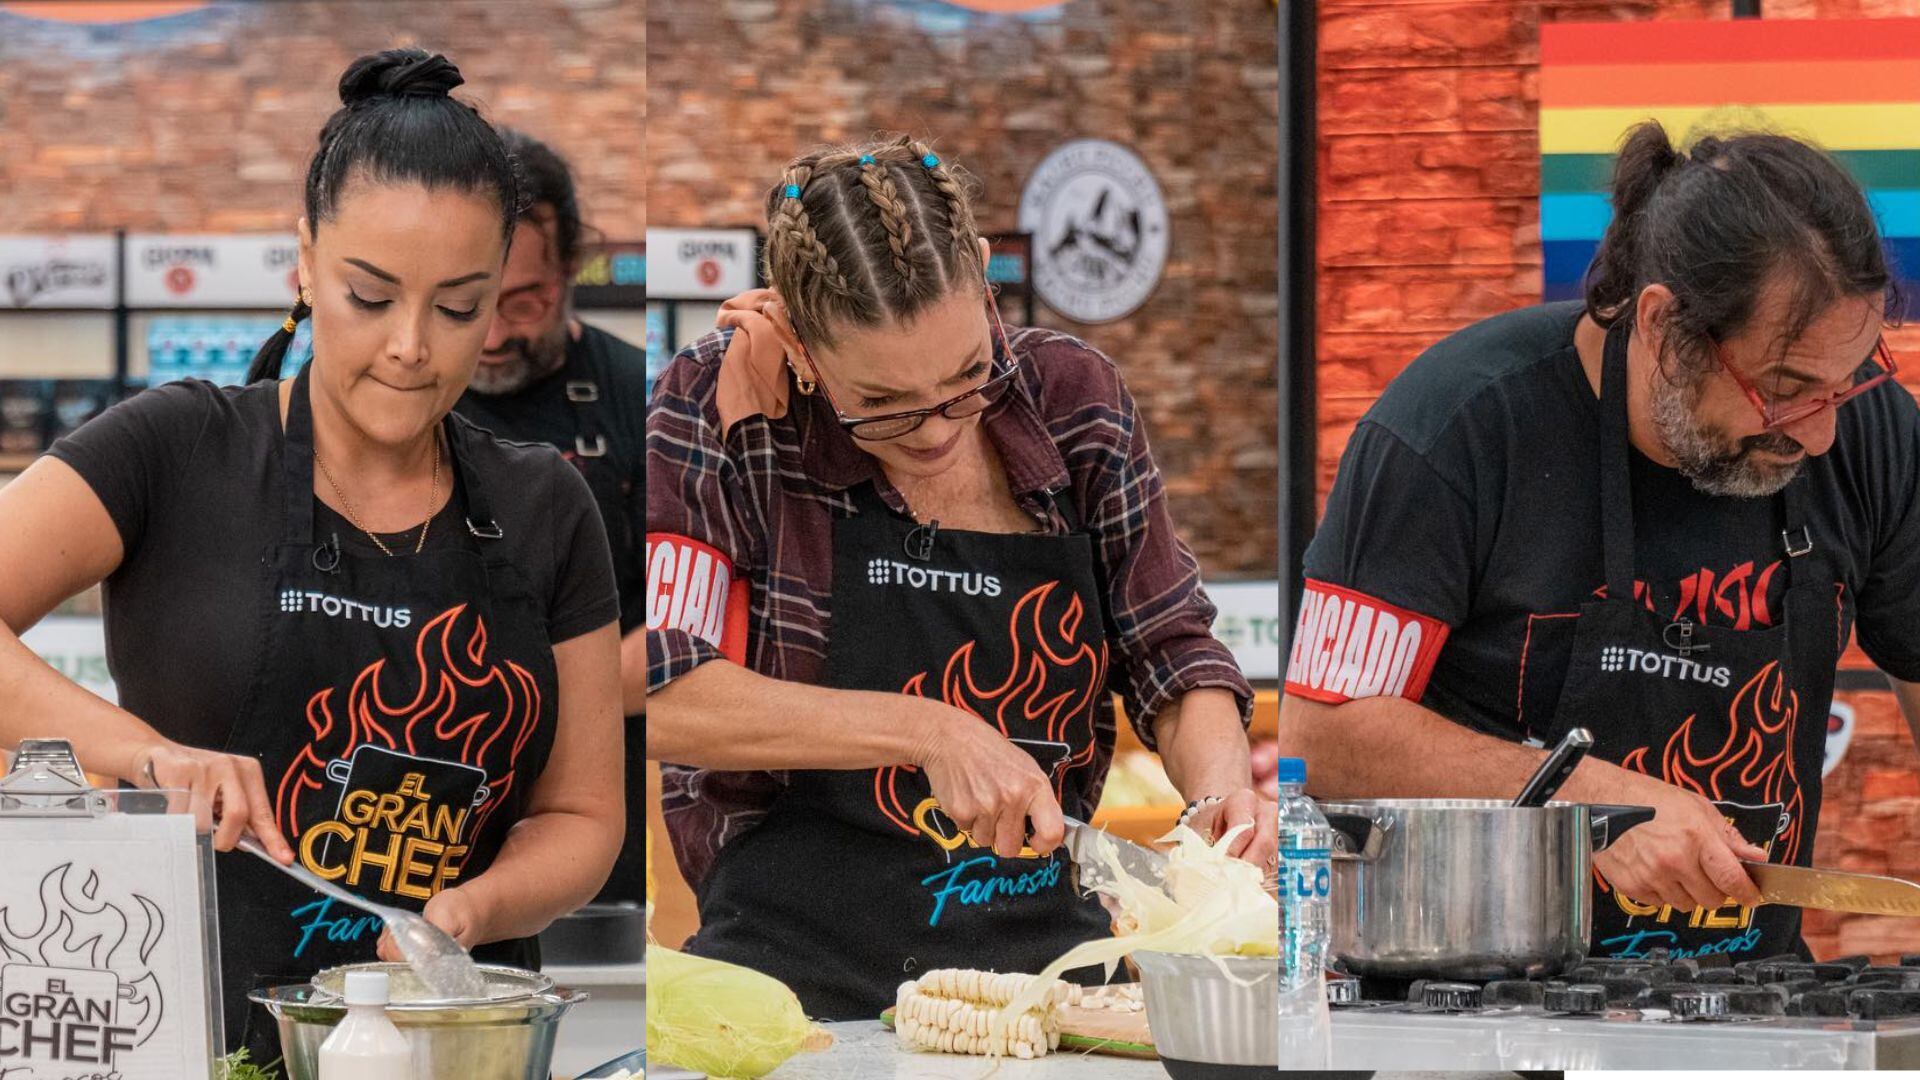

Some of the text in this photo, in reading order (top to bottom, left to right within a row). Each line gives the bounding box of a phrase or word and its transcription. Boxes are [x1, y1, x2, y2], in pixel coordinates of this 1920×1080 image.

[646, 541, 730, 649] CIAD
[891, 561, 1002, 597] TOTTUS
[304, 592, 412, 628] TOTTUS
[1626, 649, 1731, 688] TOTTUS
[398, 772, 431, 801] EL
[342, 790, 467, 844] GRAN
[300, 820, 468, 899] CHEF
[921, 856, 1061, 927] Famosos
[47, 978, 74, 996] EL
[5, 992, 111, 1024] GRAN
